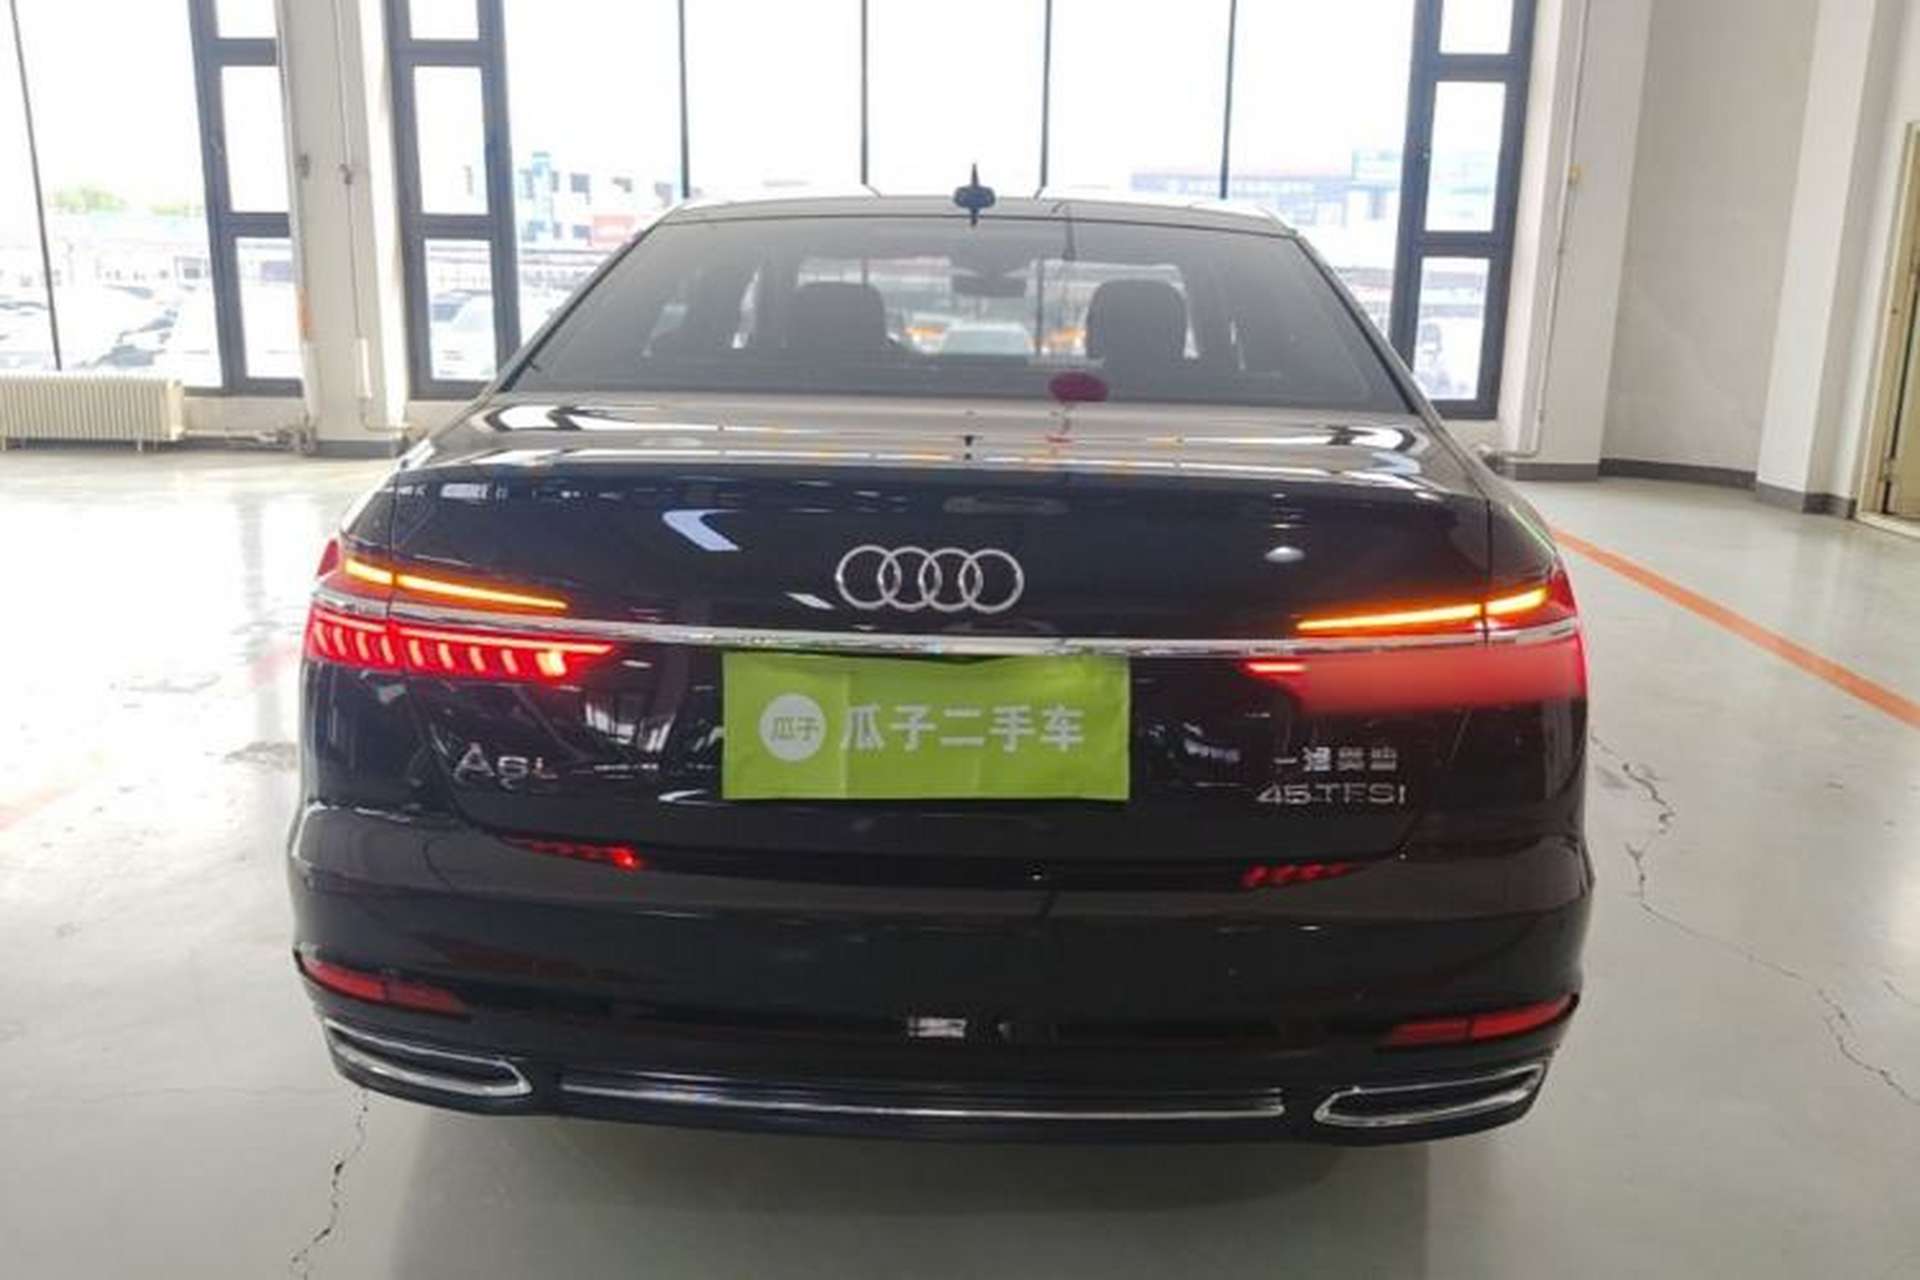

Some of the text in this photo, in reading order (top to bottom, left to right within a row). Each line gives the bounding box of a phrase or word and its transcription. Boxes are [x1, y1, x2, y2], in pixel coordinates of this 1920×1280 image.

[770, 703, 1085, 753] 瓜子 瓜子二手车
